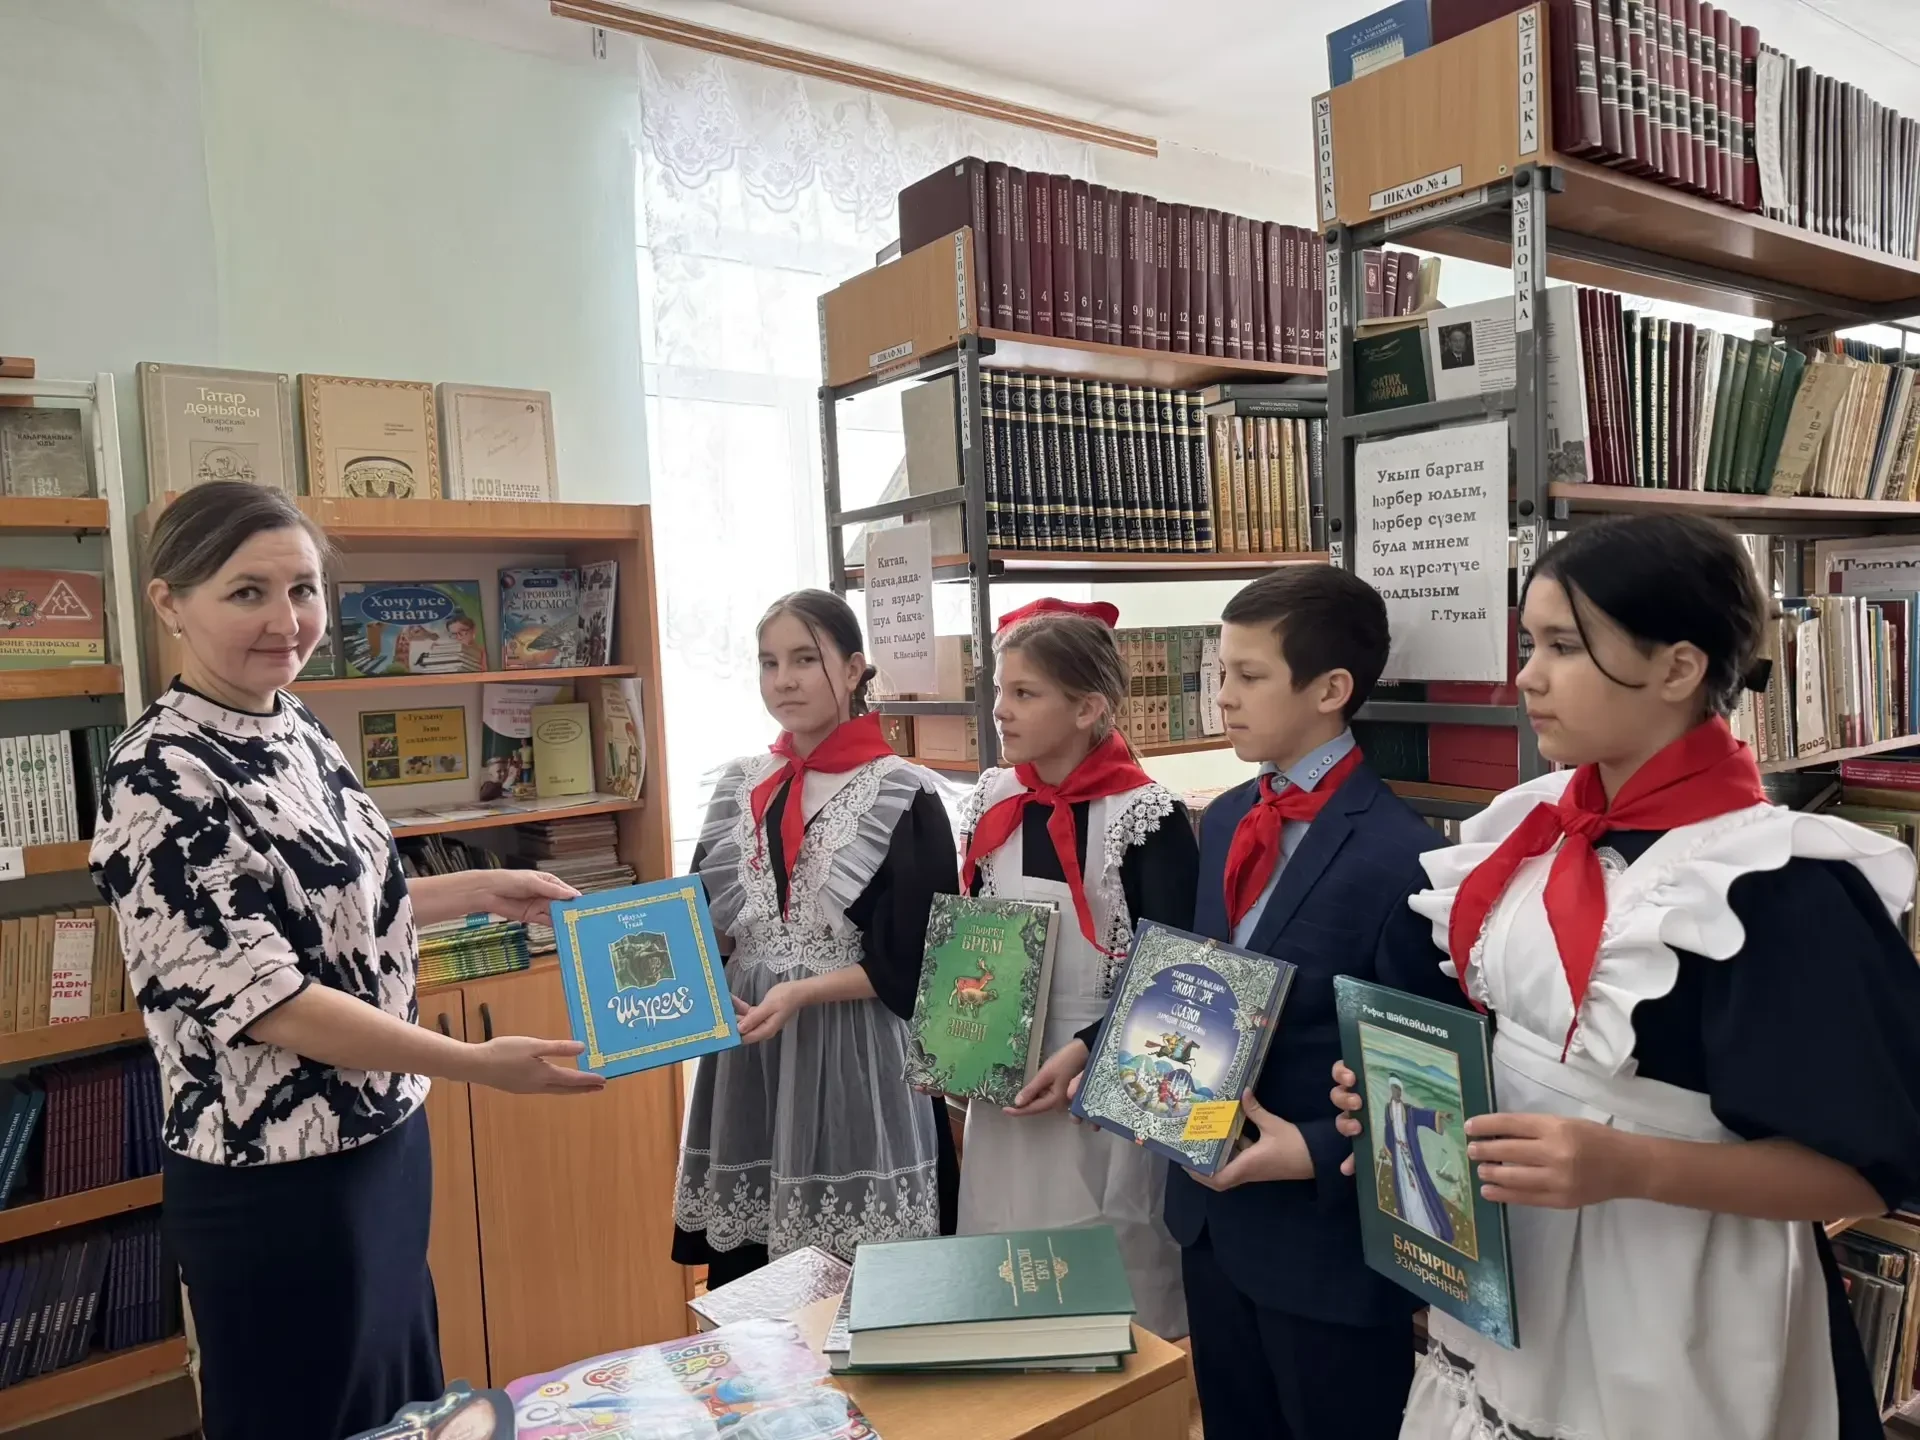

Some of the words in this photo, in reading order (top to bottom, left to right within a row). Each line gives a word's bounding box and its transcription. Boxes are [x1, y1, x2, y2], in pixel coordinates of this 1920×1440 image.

[1383, 183, 1423, 205] ШКАФ
[1441, 174, 1448, 186] 4
[1002, 283, 1009, 295] 2
[1019, 288, 1026, 300] 3
[1041, 290, 1048, 302] 4
[1063, 291, 1070, 302] 5
[1081, 296, 1088, 307] 6
[1098, 299, 1104, 310] 7
[1113, 304, 1119, 314] 8
[1132, 305, 1139, 315] 9
[1146, 307, 1154, 318] 10
[1159, 312, 1167, 322] 11
[1179, 312, 1188, 322] 12
[1198, 315, 1205, 325] 13
[1286, 326, 1295, 337] 24
[1301, 329, 1310, 339] 25
[1314, 330, 1324, 340] 26
[196, 387, 246, 406] Татар
[184, 402, 261, 418] дөньясы
[201, 416, 246, 426] Татарский
[989, 425, 997, 493] ЭНЦИКЛОПЕДИЯ
[1022, 428, 1031, 496] ЭНЦИКЛОПЕДИЯ
[1376, 467, 1420, 485] Укып
[1425, 458, 1485, 480] барган
[31, 477, 59, 488] 1941
[1372, 490, 1423, 510] һәрбер
[1427, 485, 1488, 502] юлым,
[1372, 515, 1423, 533] һәрбер
[1427, 509, 1477, 528] сүзем
[1372, 538, 1407, 557] була
[1411, 534, 1470, 551] минем
[877, 555, 908, 569] Китап,
[1372, 564, 1395, 578] юл
[1399, 558, 1480, 579] күрсәтүче
[512, 590, 572, 600] АСТРОНОМИЯ
[370, 595, 414, 610] Хочу
[418, 596, 447, 606] все
[522, 599, 573, 611] КОСМОС
[380, 608, 440, 621] знать
[872, 616, 891, 629] шул
[896, 612, 925, 624] бакча-
[1430, 607, 1487, 623] Г.Тукай
[88, 642, 98, 653] 2
[1799, 736, 1826, 753] 2002
[624, 919, 644, 930] Тукай
[961, 934, 1004, 954] БРЕМ
[52, 990, 83, 998] ЛЕК
[1171, 1003, 1201, 1024] СКАЗКИ
[947, 1018, 988, 1043] ЗВЕРИ
[1392, 1232, 1467, 1288] БАТЫРША
[1394, 1254, 1470, 1306] эзләреннән
